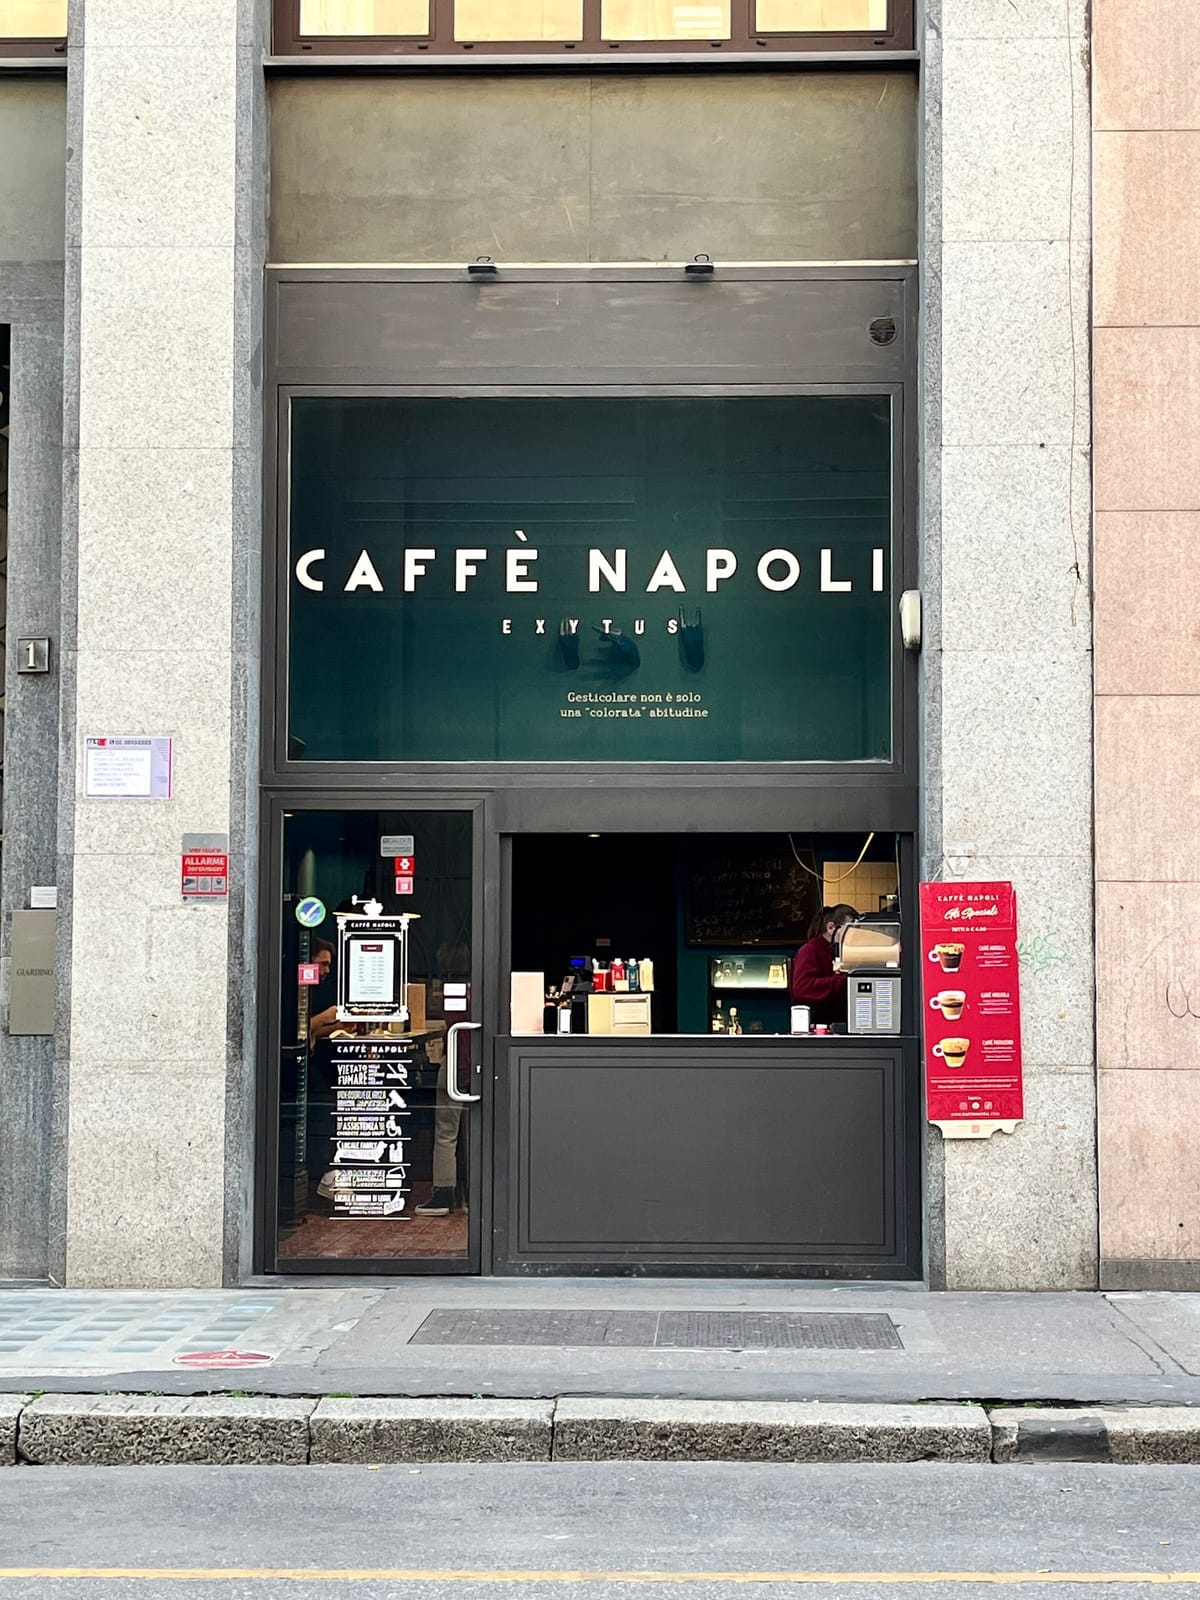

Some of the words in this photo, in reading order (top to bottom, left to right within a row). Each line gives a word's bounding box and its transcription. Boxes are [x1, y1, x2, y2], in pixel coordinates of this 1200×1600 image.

[295, 530, 540, 593] CAFFÈ
[588, 548, 884, 594] NAPOLI
[502, 618, 679, 636] EXYTUS
[25, 640, 37, 669] 1
[567, 691, 637, 704] Gesticolare
[639, 693, 663, 704] non
[666, 691, 673, 704] è
[675, 691, 702, 704] solo
[560, 708, 582, 719] una
[649, 705, 709, 719] abitudine
[184, 857, 226, 866] ALLARME
[937, 894, 964, 902] CAFFÈ
[16, 967, 54, 977] GIARDINO
[336, 1044, 367, 1053] CAFFÈ
[370, 1045, 408, 1053] NAPOLI
[337, 1063, 368, 1075] VIETATO
[337, 1071, 368, 1085] FUMARE
[342, 1122, 379, 1130] ASSISTENZA
